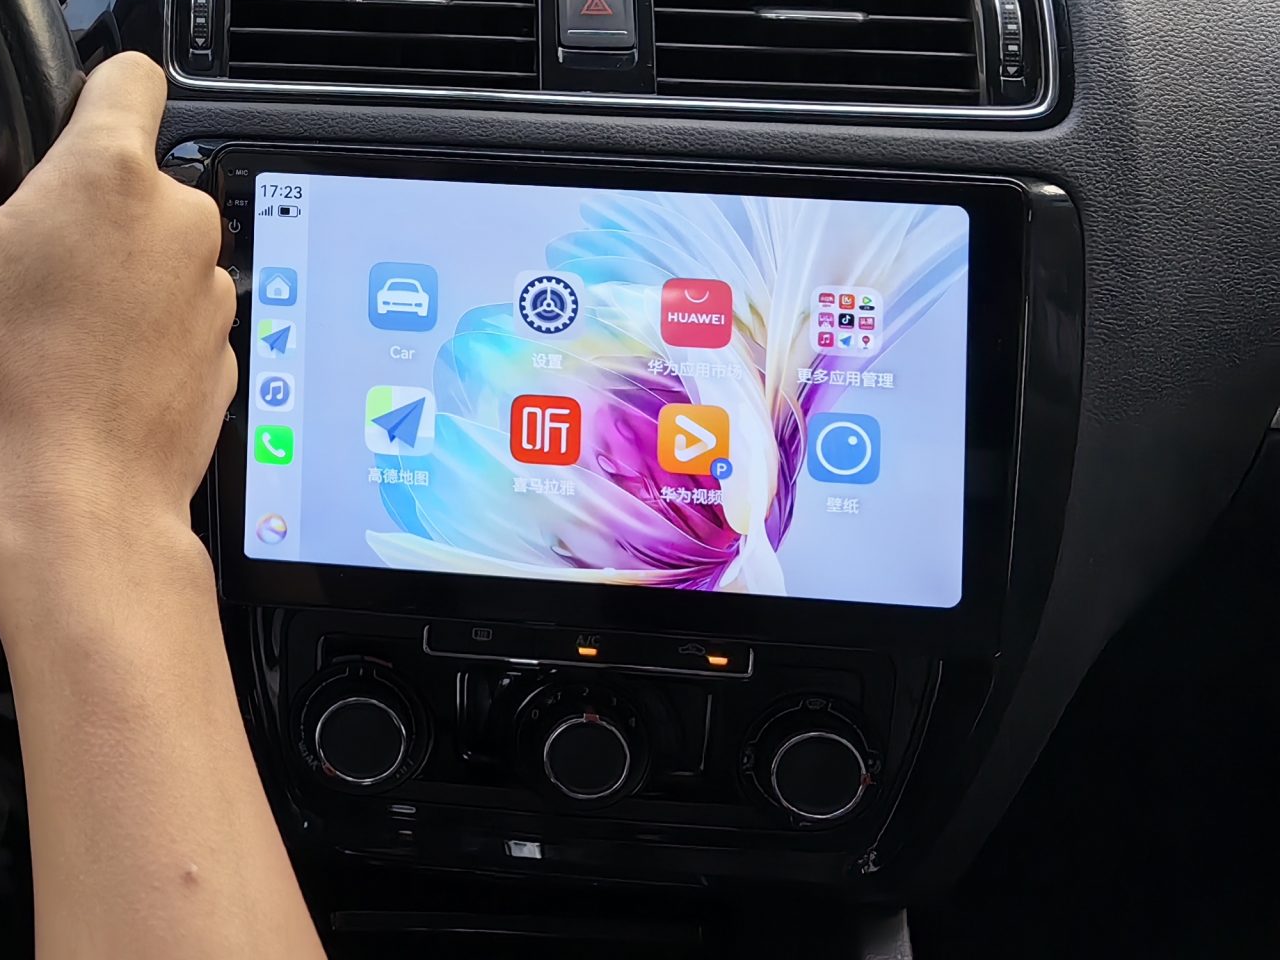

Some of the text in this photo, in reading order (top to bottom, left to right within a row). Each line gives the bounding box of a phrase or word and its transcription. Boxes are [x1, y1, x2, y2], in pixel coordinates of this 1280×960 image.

[260, 183, 303, 200] 17:23
[234, 199, 249, 207] RST
[667, 312, 725, 326] HUAWEI
[390, 344, 415, 360] Car
[531, 352, 563, 370] 设置
[796, 368, 895, 389] 更多应用管理
[521, 406, 572, 455] 听
[367, 466, 429, 487] 高德地图
[659, 485, 724, 506] 华为视频
[826, 496, 860, 515] 壁纸
[575, 634, 601, 647] A/C
